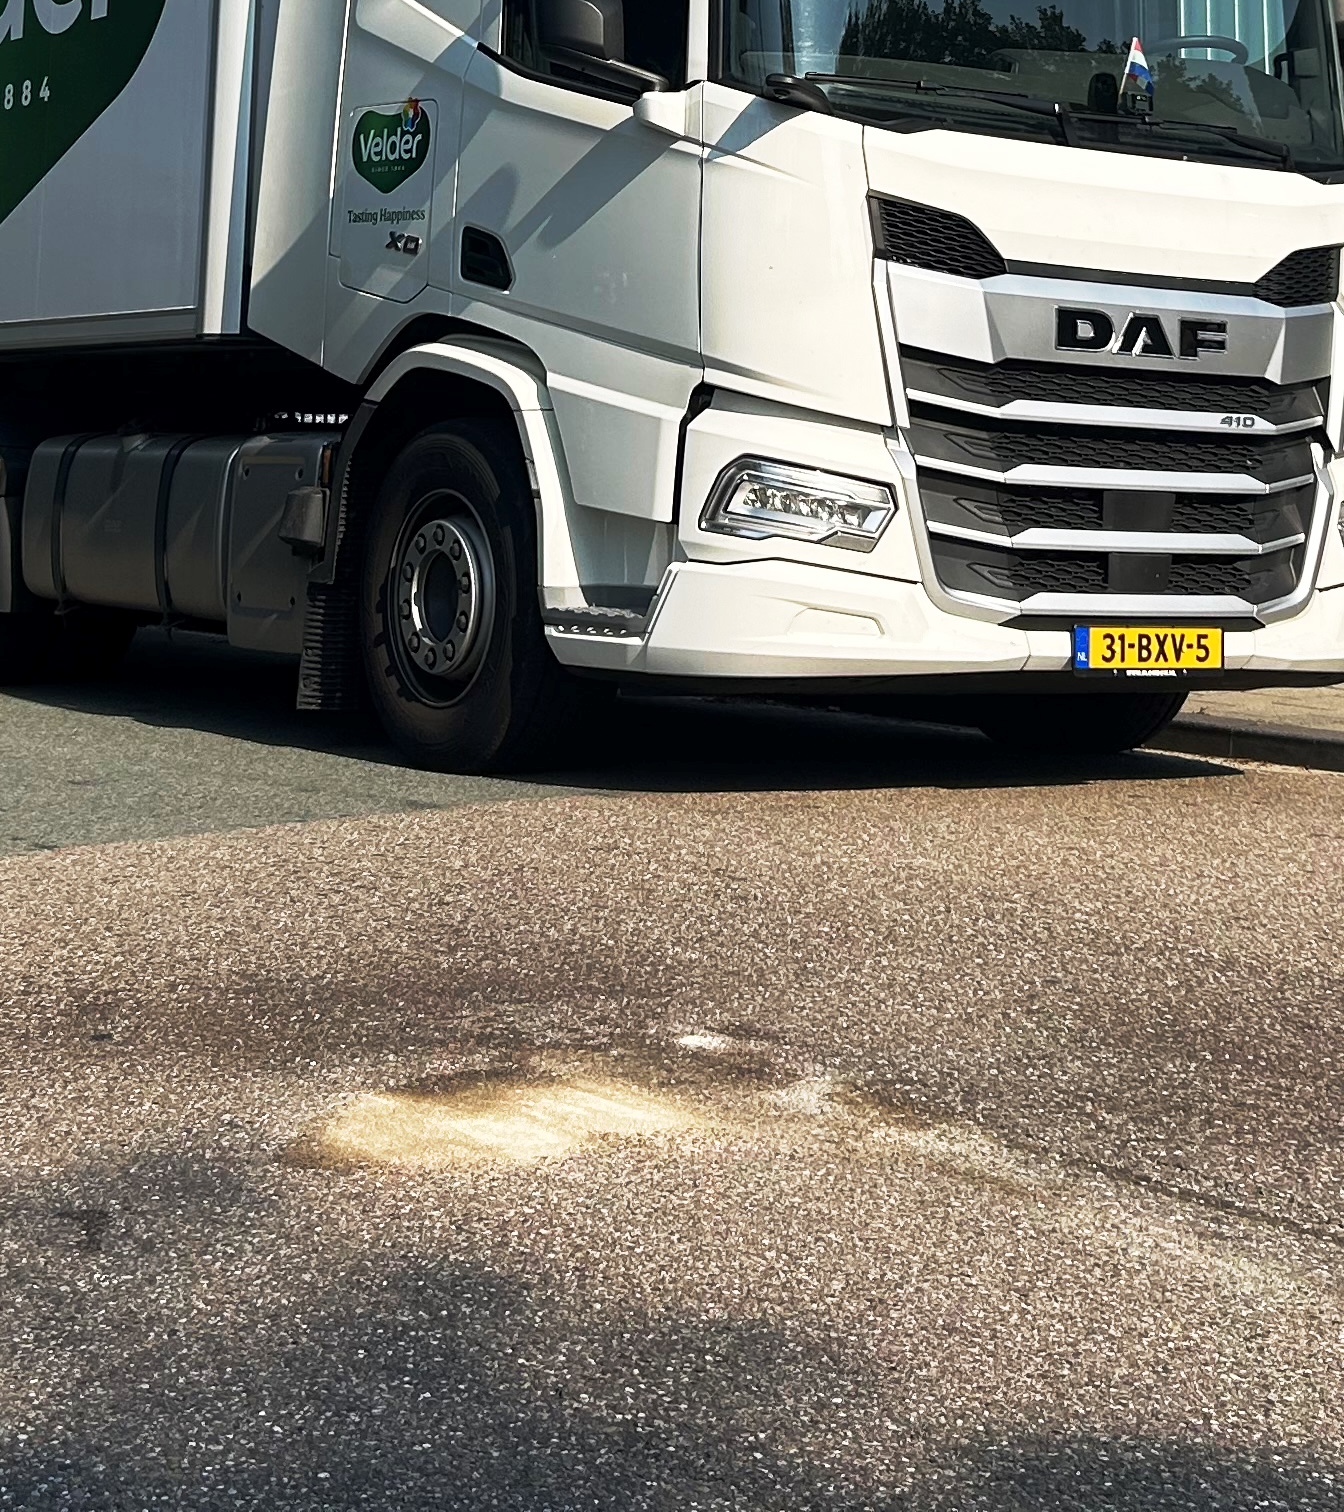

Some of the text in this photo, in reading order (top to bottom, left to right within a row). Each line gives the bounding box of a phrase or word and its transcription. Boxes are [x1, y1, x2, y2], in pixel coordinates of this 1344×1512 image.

[359, 127, 422, 162] Velder
[348, 205, 426, 225] Tasting Happiness
[1054, 305, 1228, 361] DAF
[1220, 416, 1255, 429] 410
[1077, 633, 1210, 663] NL 31-BXV-5
